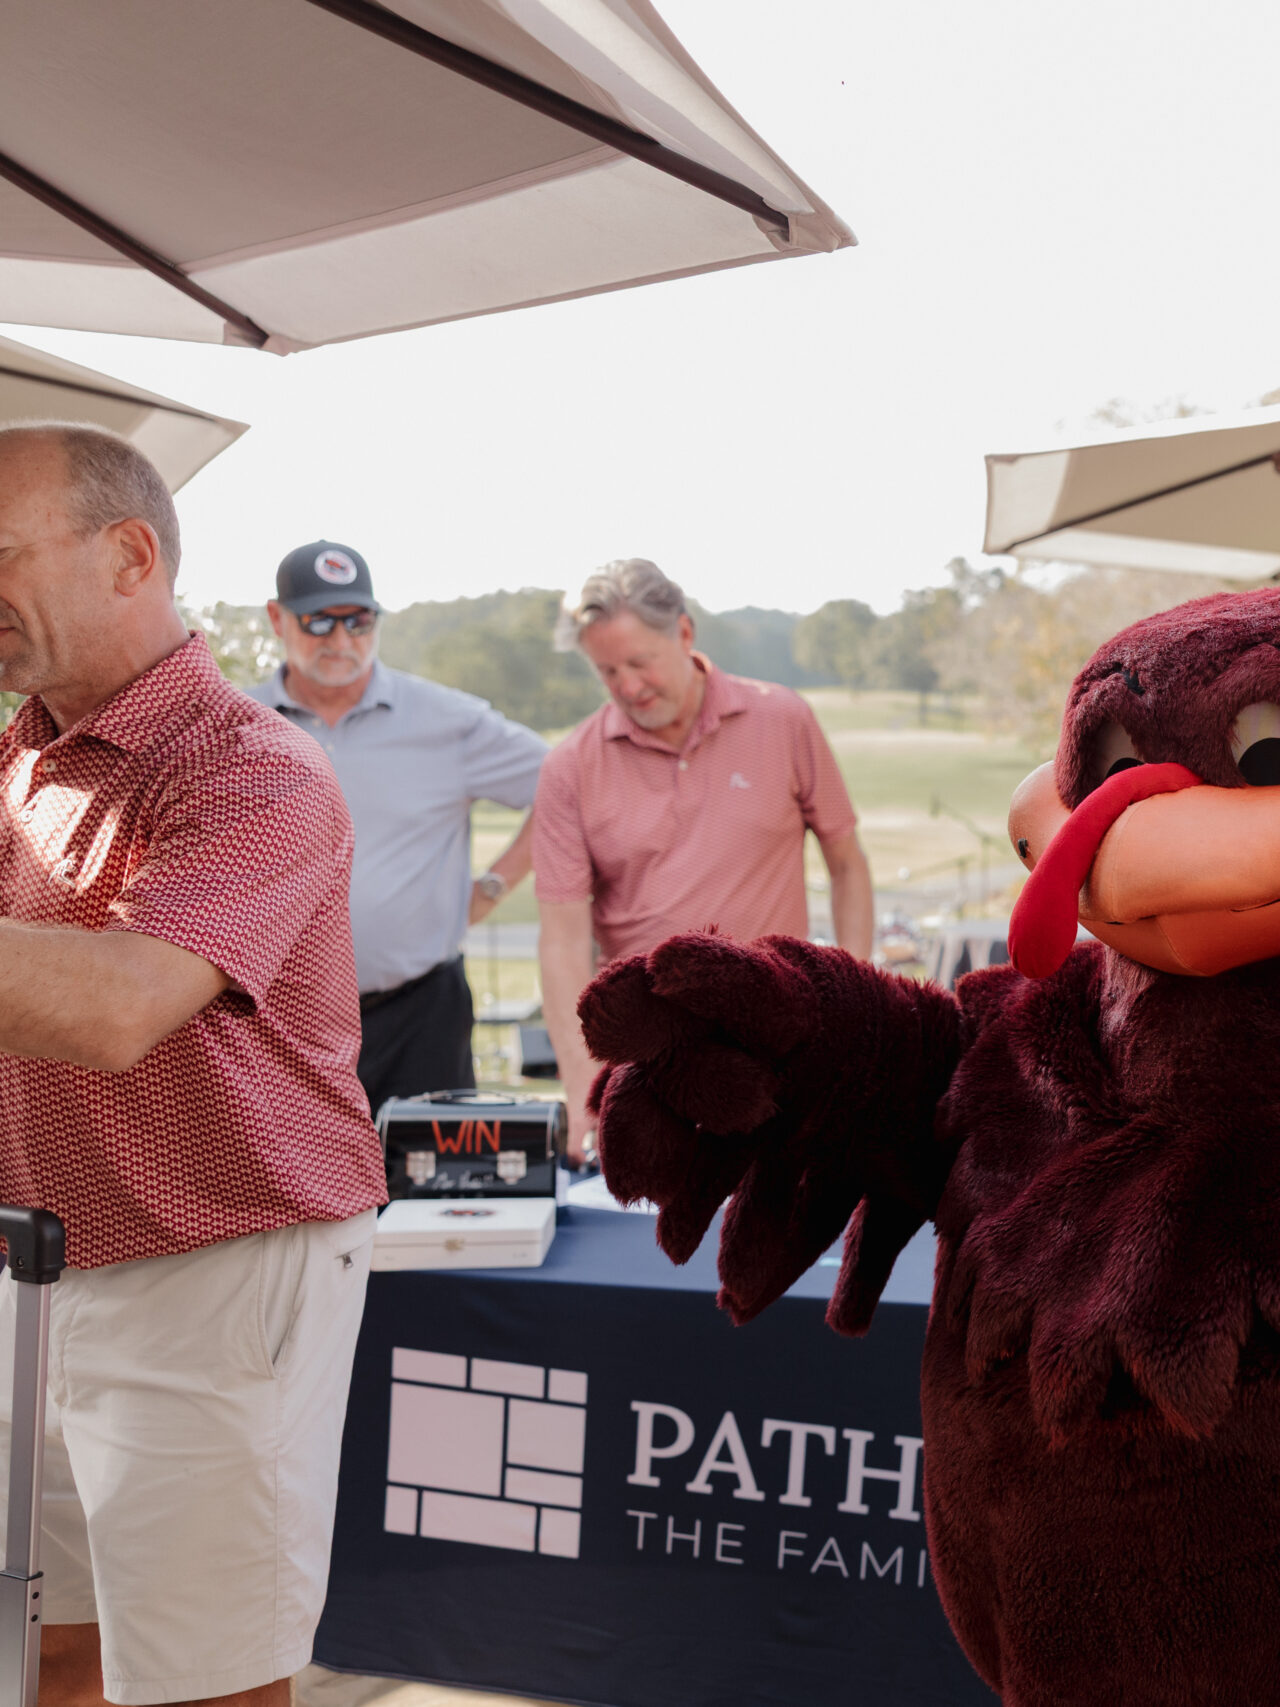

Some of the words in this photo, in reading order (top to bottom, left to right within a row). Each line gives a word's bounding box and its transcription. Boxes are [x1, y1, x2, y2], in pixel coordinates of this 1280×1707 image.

[431, 1117, 501, 1155] WIN
[626, 1400, 925, 1522] PATH
[626, 1510, 746, 1565] THE
[777, 1530, 927, 1588] FAMI
